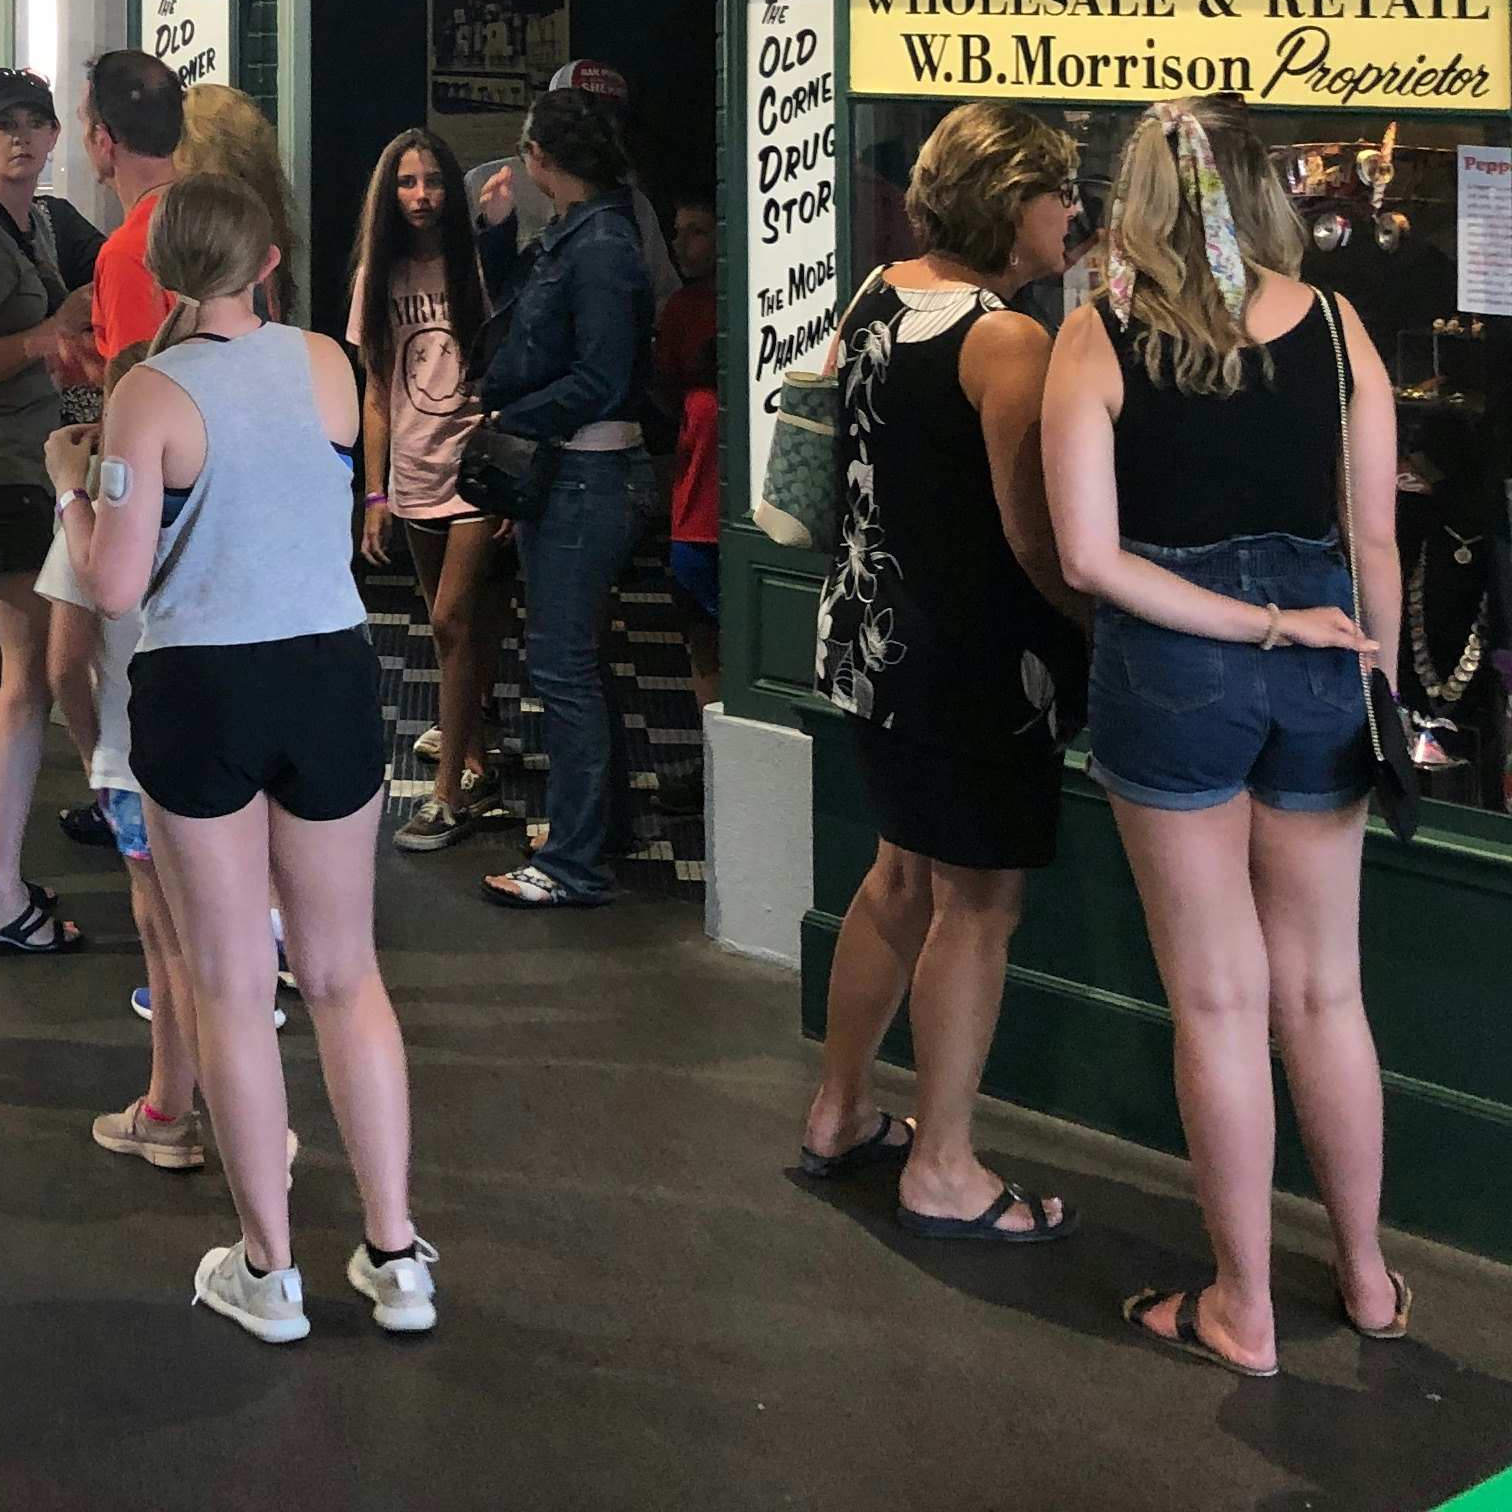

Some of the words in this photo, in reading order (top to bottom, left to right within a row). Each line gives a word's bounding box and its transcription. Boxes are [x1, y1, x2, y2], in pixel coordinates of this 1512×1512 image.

[155, 19, 195, 58] OLD
[759, 28, 817, 78] OLD
[1261, 25, 1491, 105] Proprietor
[179, 47, 216, 89] RNER
[759, 72, 833, 135] CORNE
[758, 124, 836, 193] DRUG
[1463, 155, 1512, 175] Pepp
[761, 180, 835, 244] STOR
[788, 252, 835, 306] MODE
[756, 301, 838, 382] PHARMAC
